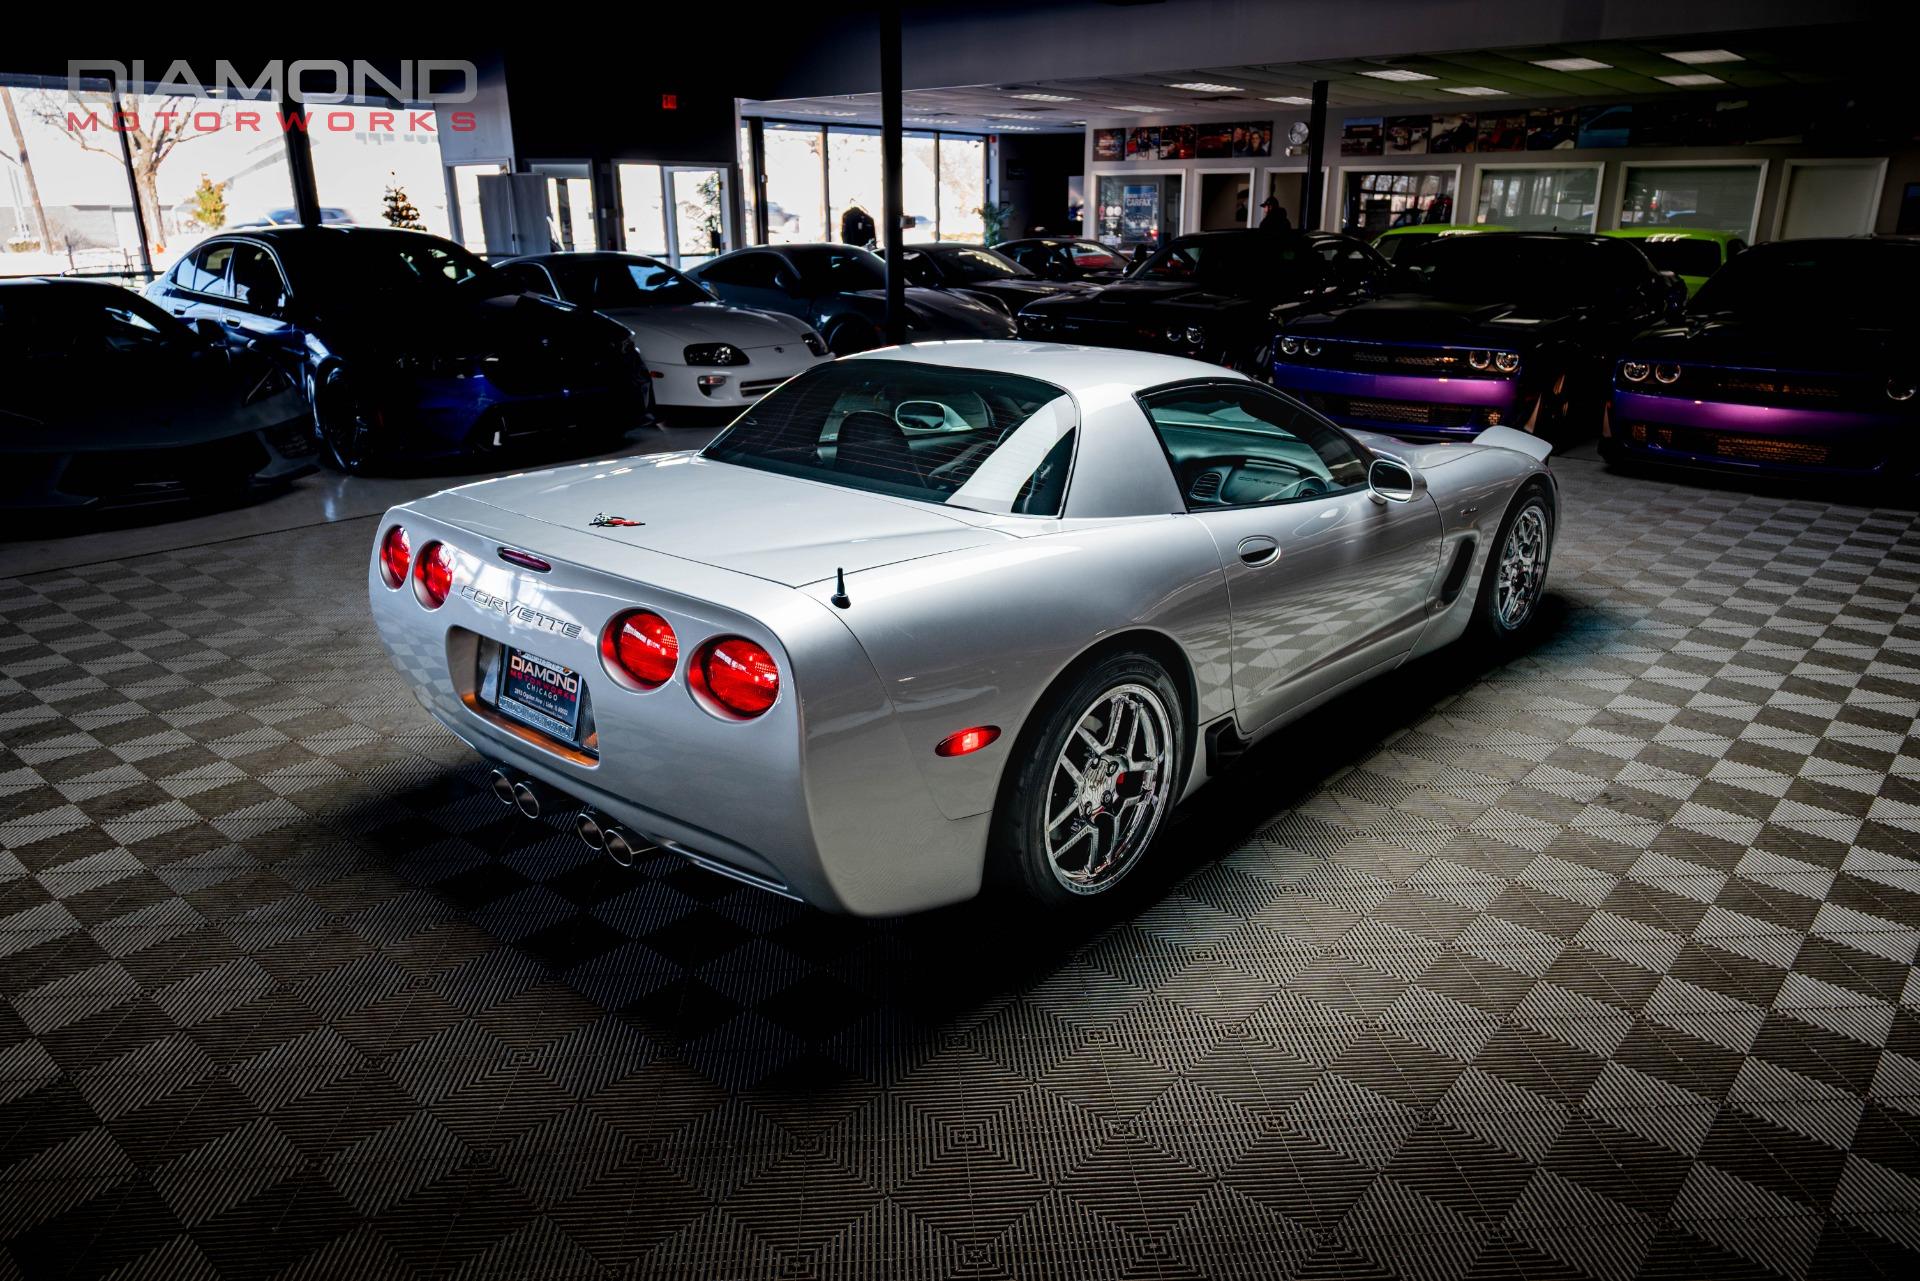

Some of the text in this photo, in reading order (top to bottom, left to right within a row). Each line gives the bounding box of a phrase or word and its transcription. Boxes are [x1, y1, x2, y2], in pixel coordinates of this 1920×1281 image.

[460, 585, 582, 639] CORVETTE
[510, 655, 577, 694] DIAMOND
[526, 682, 558, 702] CHICAGO
